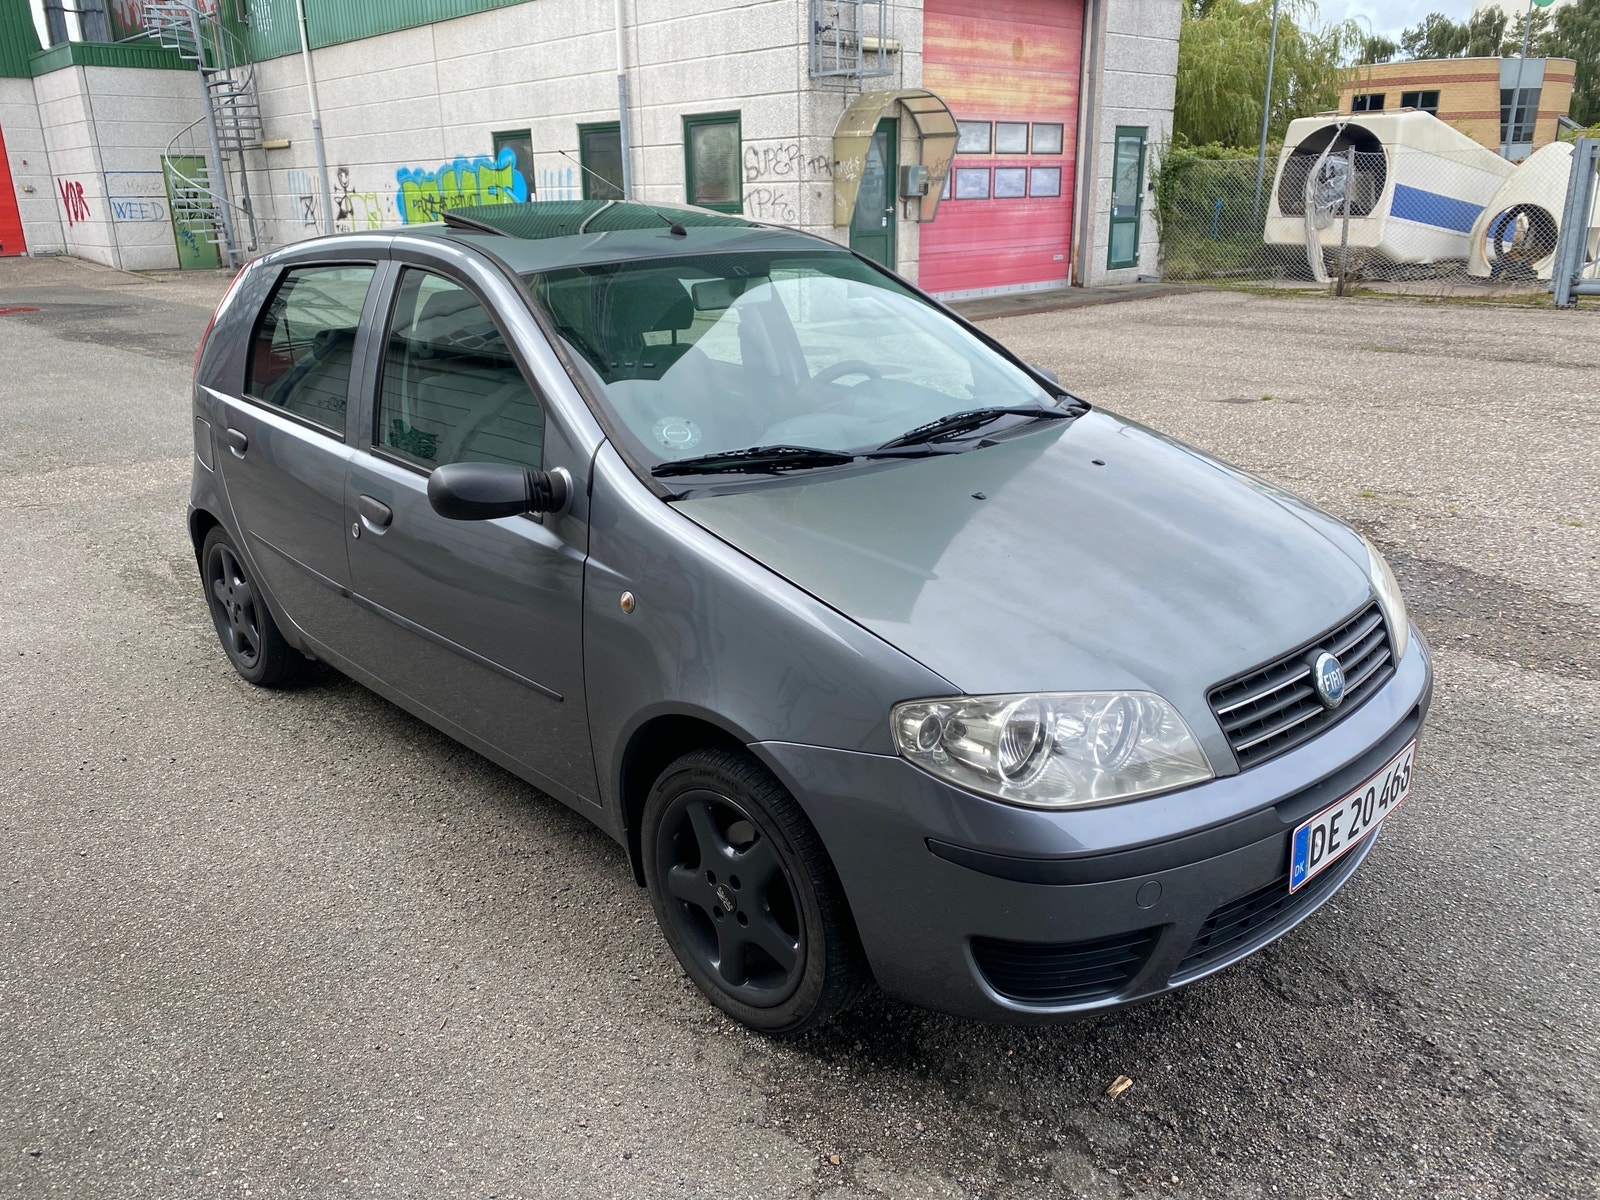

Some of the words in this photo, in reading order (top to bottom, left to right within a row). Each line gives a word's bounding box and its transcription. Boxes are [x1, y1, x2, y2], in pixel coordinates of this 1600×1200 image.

[112, 201, 165, 220] WEED
[1323, 668, 1344, 692] FIAT
[1310, 808, 1344, 869] DE
[1347, 786, 1376, 842] 20
[1378, 752, 1412, 810] 466
[1294, 860, 1305, 878] DK
